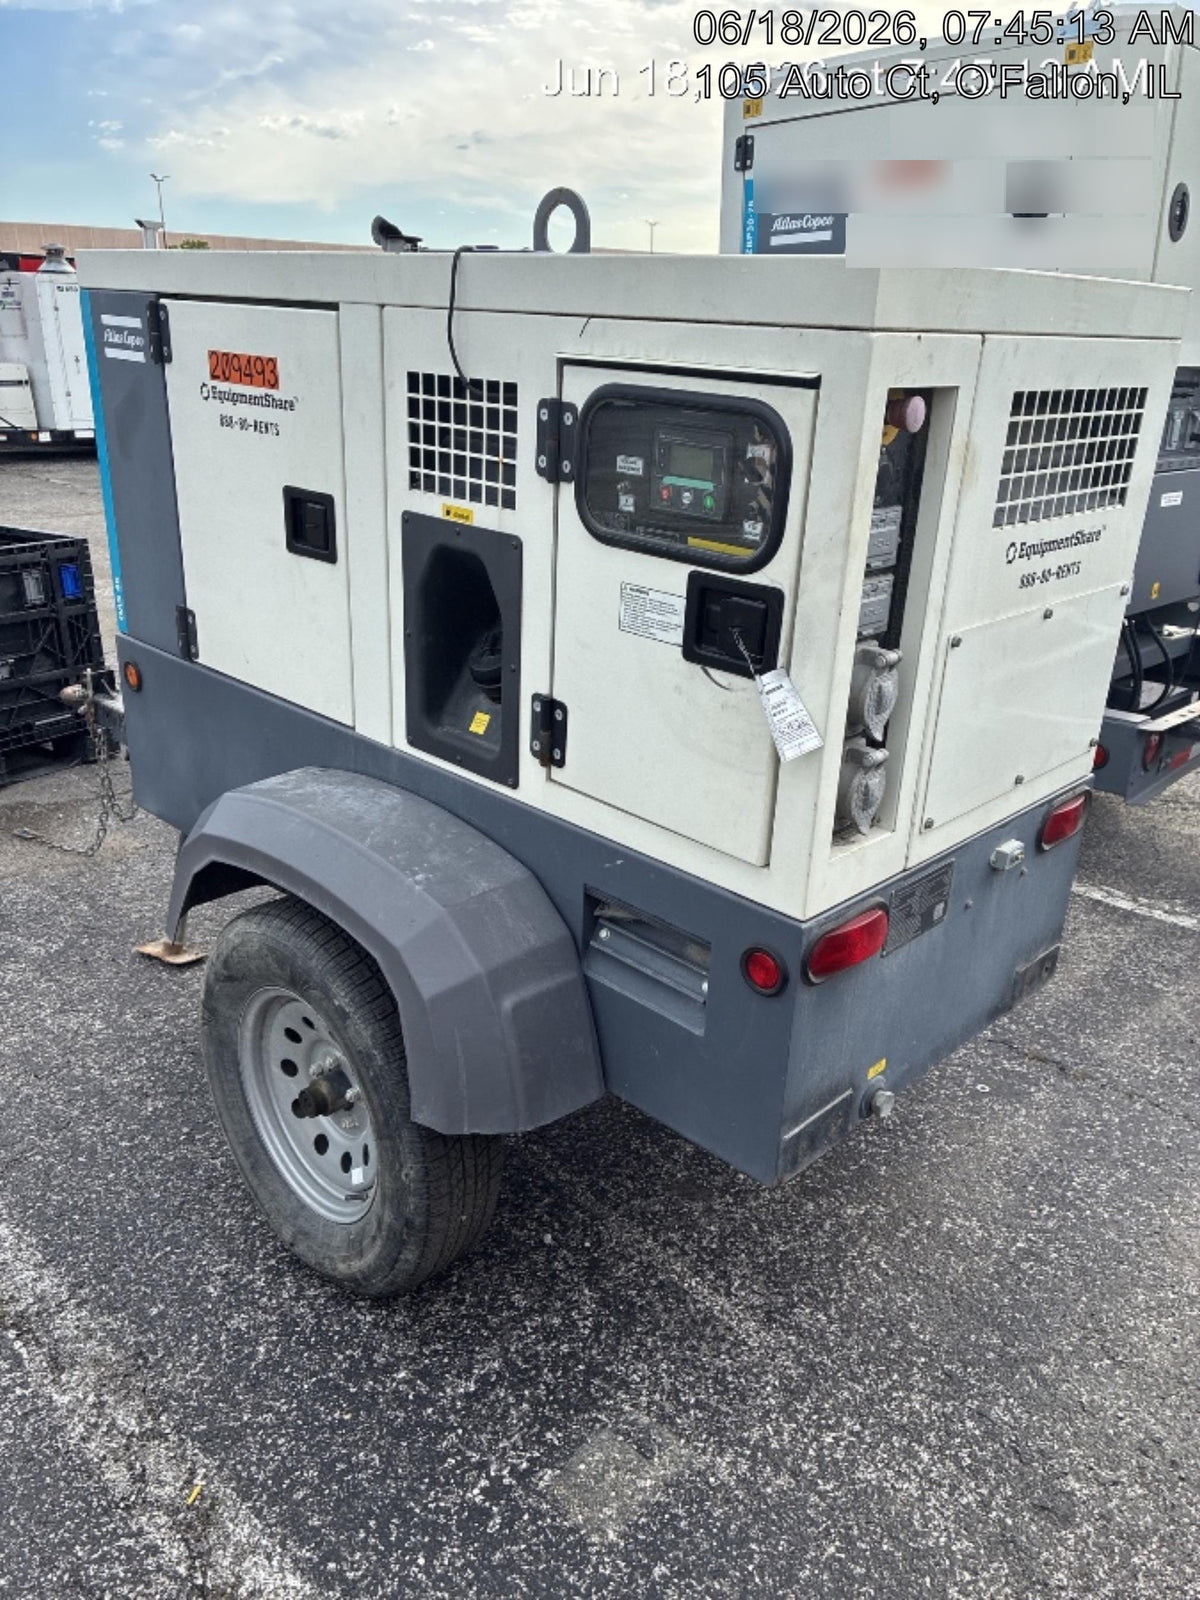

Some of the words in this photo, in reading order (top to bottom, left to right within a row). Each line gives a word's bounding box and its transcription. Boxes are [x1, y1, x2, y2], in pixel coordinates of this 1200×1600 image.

[208, 350, 279, 389] 209493
[210, 385, 296, 412] EquipmentShare
[1017, 528, 1103, 561] EquipmentShare
